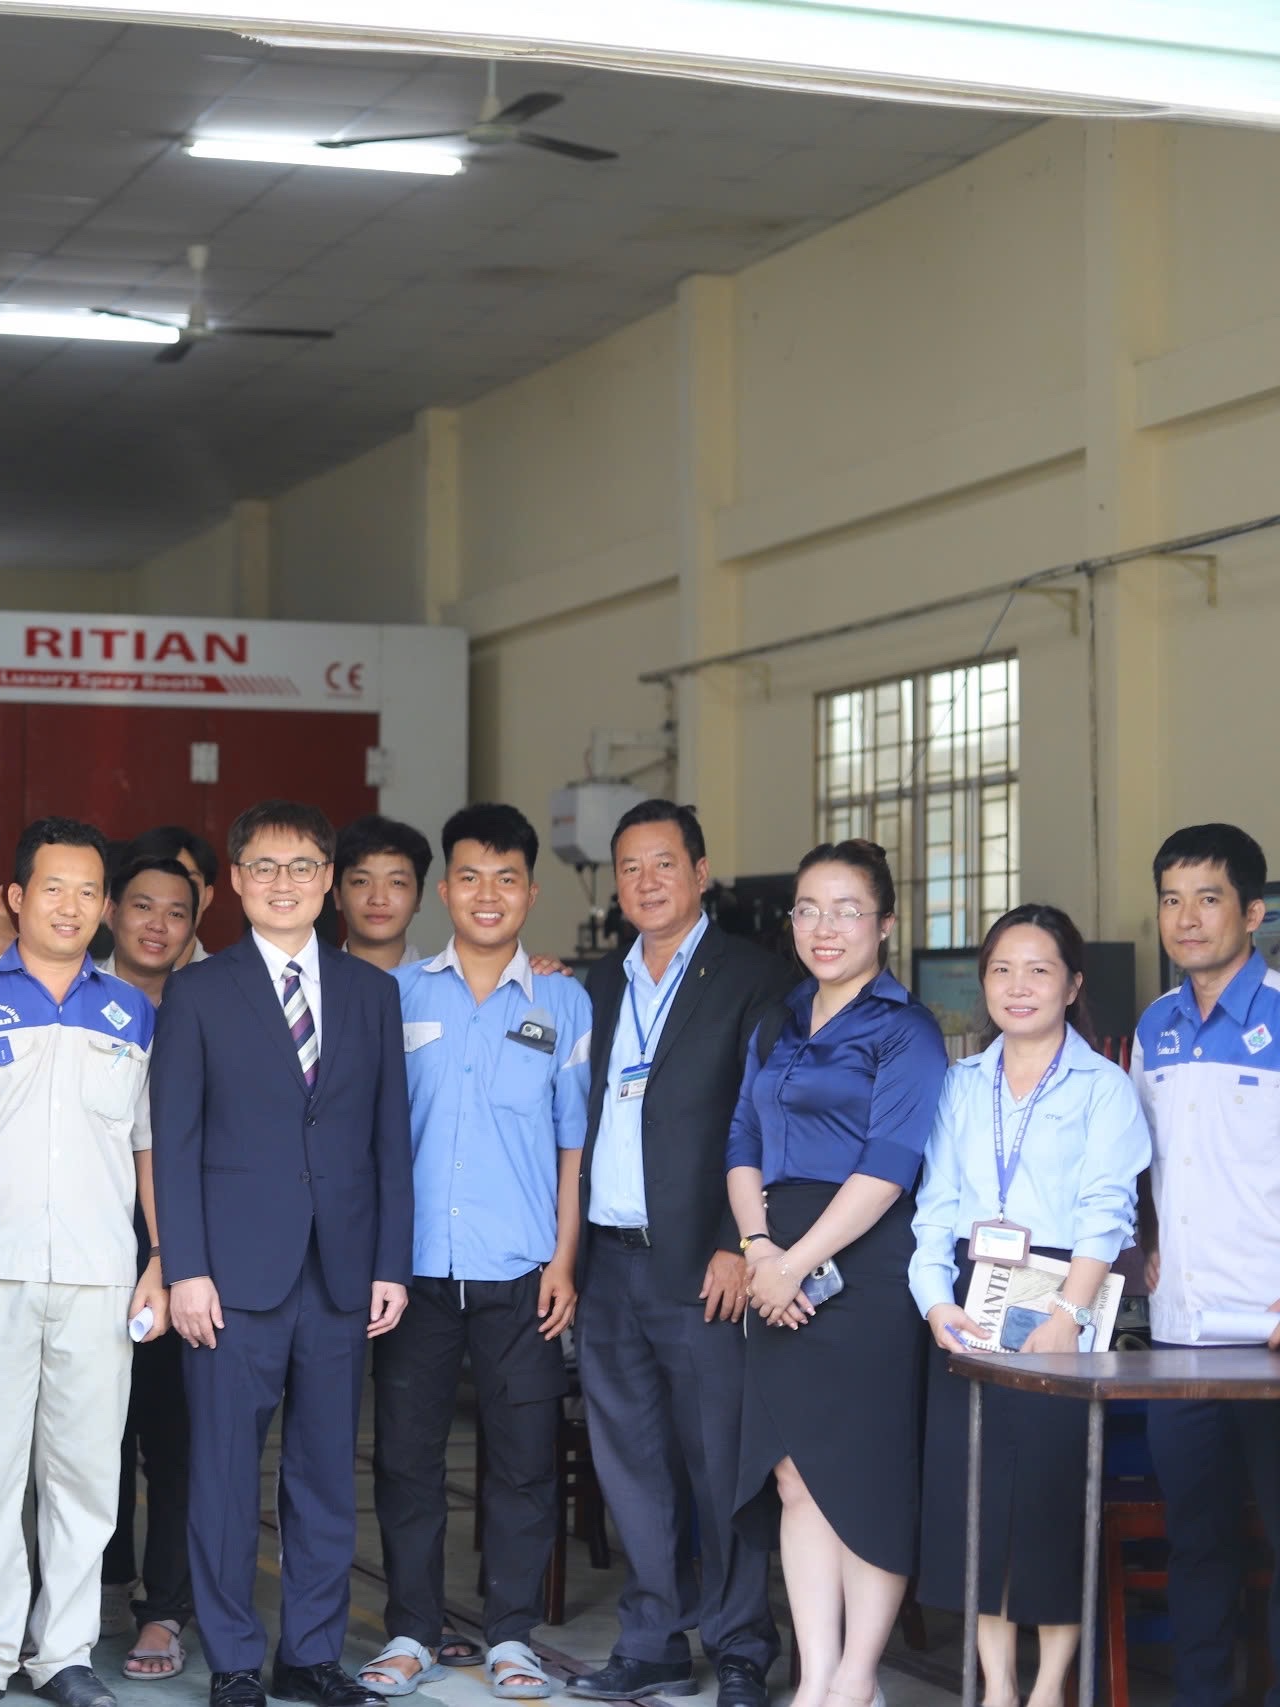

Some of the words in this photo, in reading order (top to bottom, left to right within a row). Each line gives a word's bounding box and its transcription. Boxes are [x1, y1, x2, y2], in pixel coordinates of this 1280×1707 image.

[24, 627, 248, 664] RITIAN
[0, 669, 74, 689] Luxury
[324, 661, 366, 691] CE
